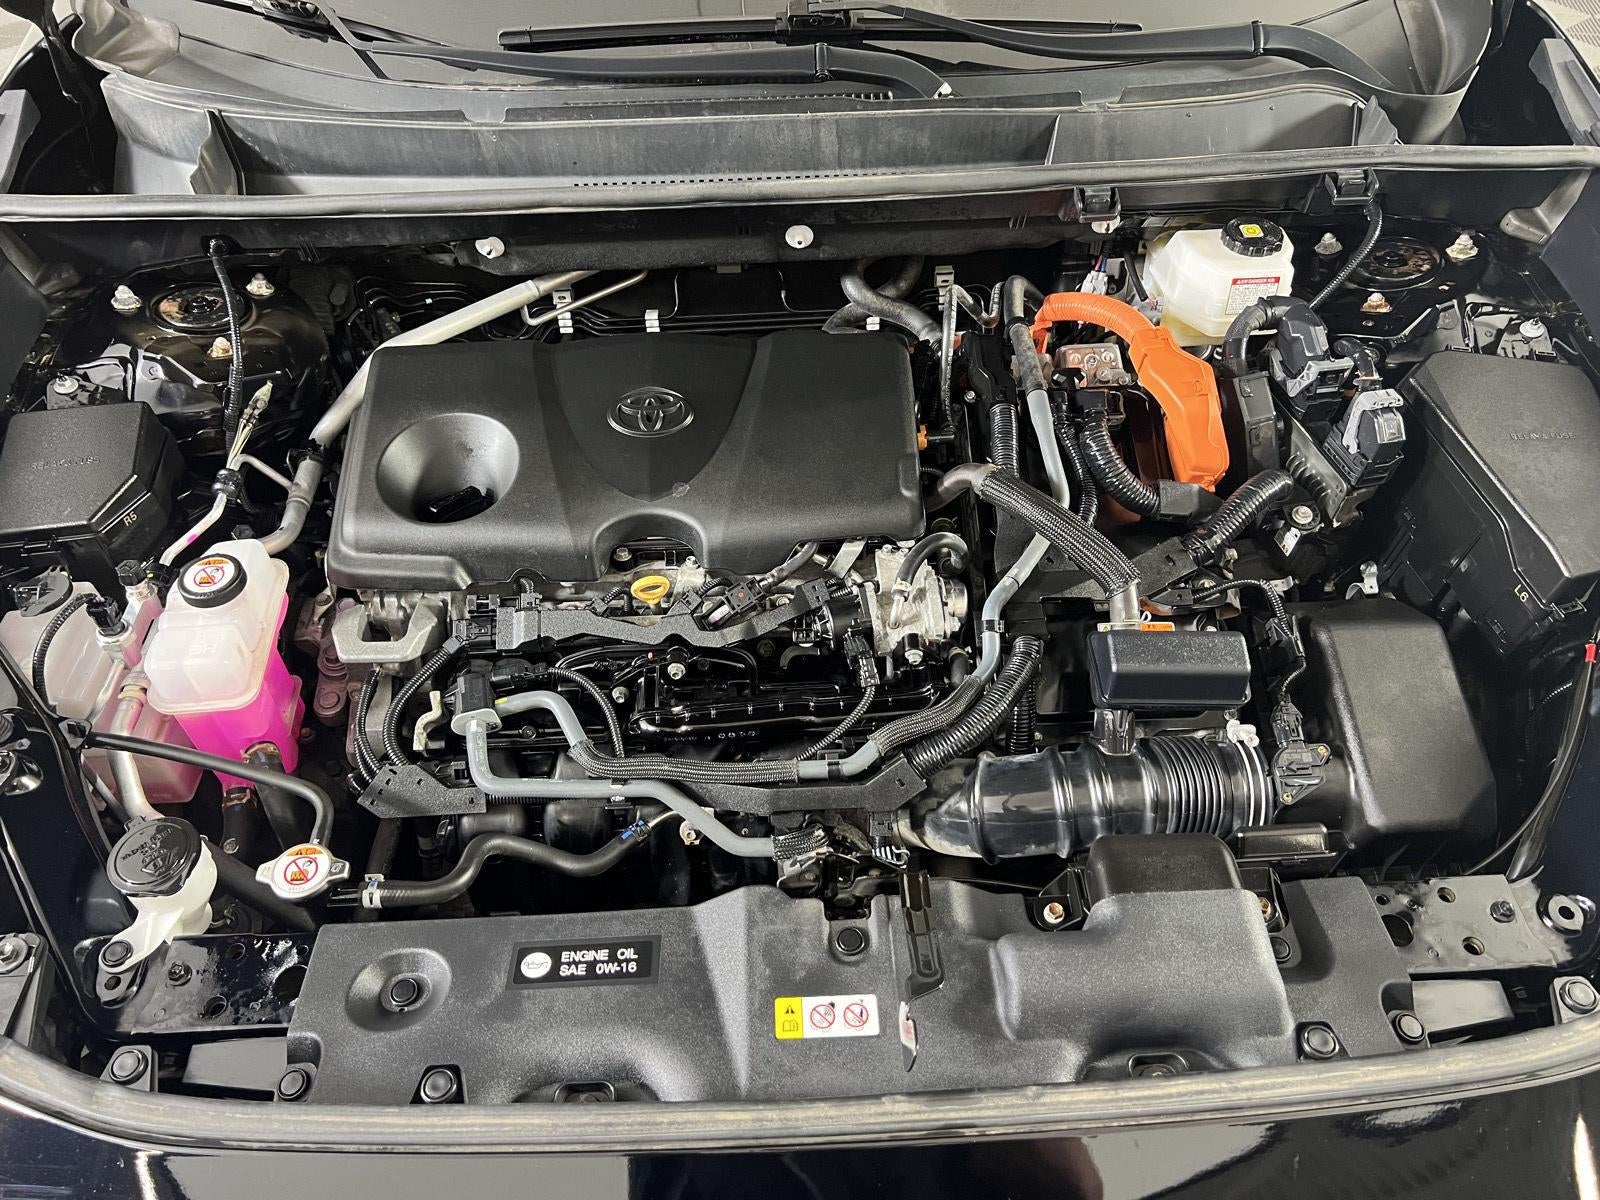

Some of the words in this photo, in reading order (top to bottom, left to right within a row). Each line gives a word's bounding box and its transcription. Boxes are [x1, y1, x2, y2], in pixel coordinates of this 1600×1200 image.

[123, 511, 138, 527] R5
[1514, 583, 1529, 602] L6
[560, 949, 609, 962] ENGINE
[616, 947, 638, 960] OIL
[559, 963, 587, 976] SAE
[595, 961, 637, 975] 0W-16
